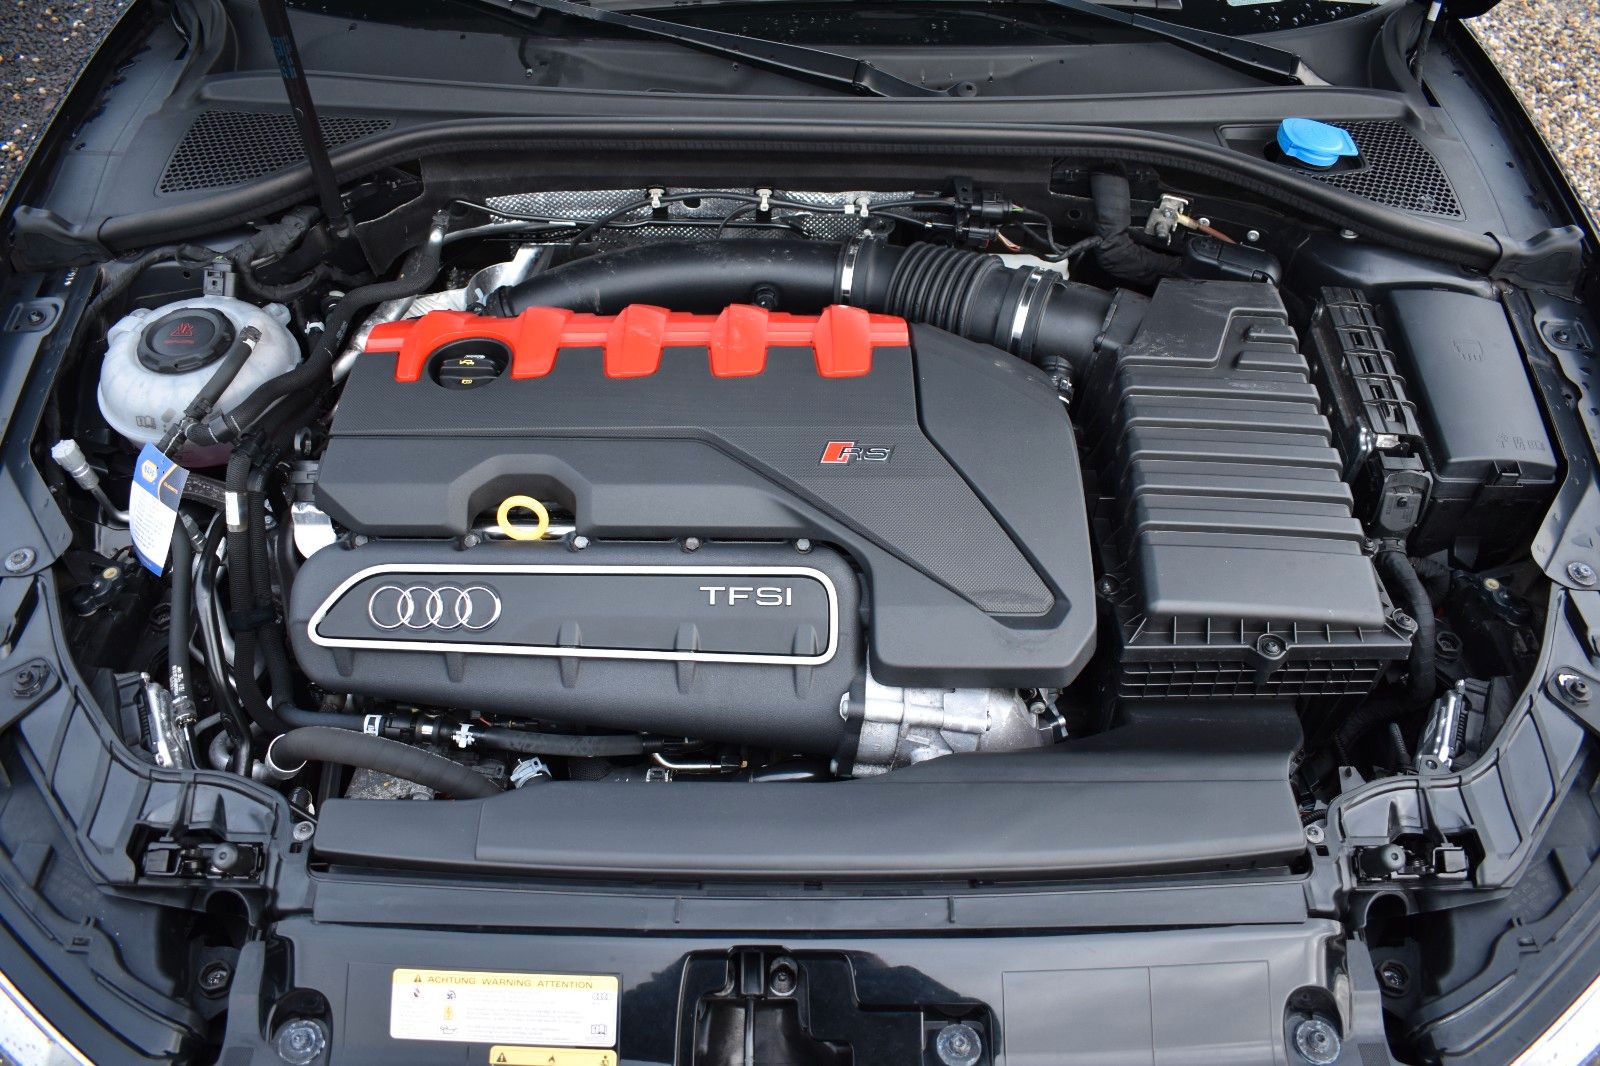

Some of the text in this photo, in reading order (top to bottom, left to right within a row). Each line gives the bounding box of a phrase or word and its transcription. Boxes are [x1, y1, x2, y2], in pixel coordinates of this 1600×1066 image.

[836, 446, 891, 462] RS
[699, 586, 793, 607] TFSI
[427, 975, 594, 990] ACHTUNG WARNING ATTENTION
